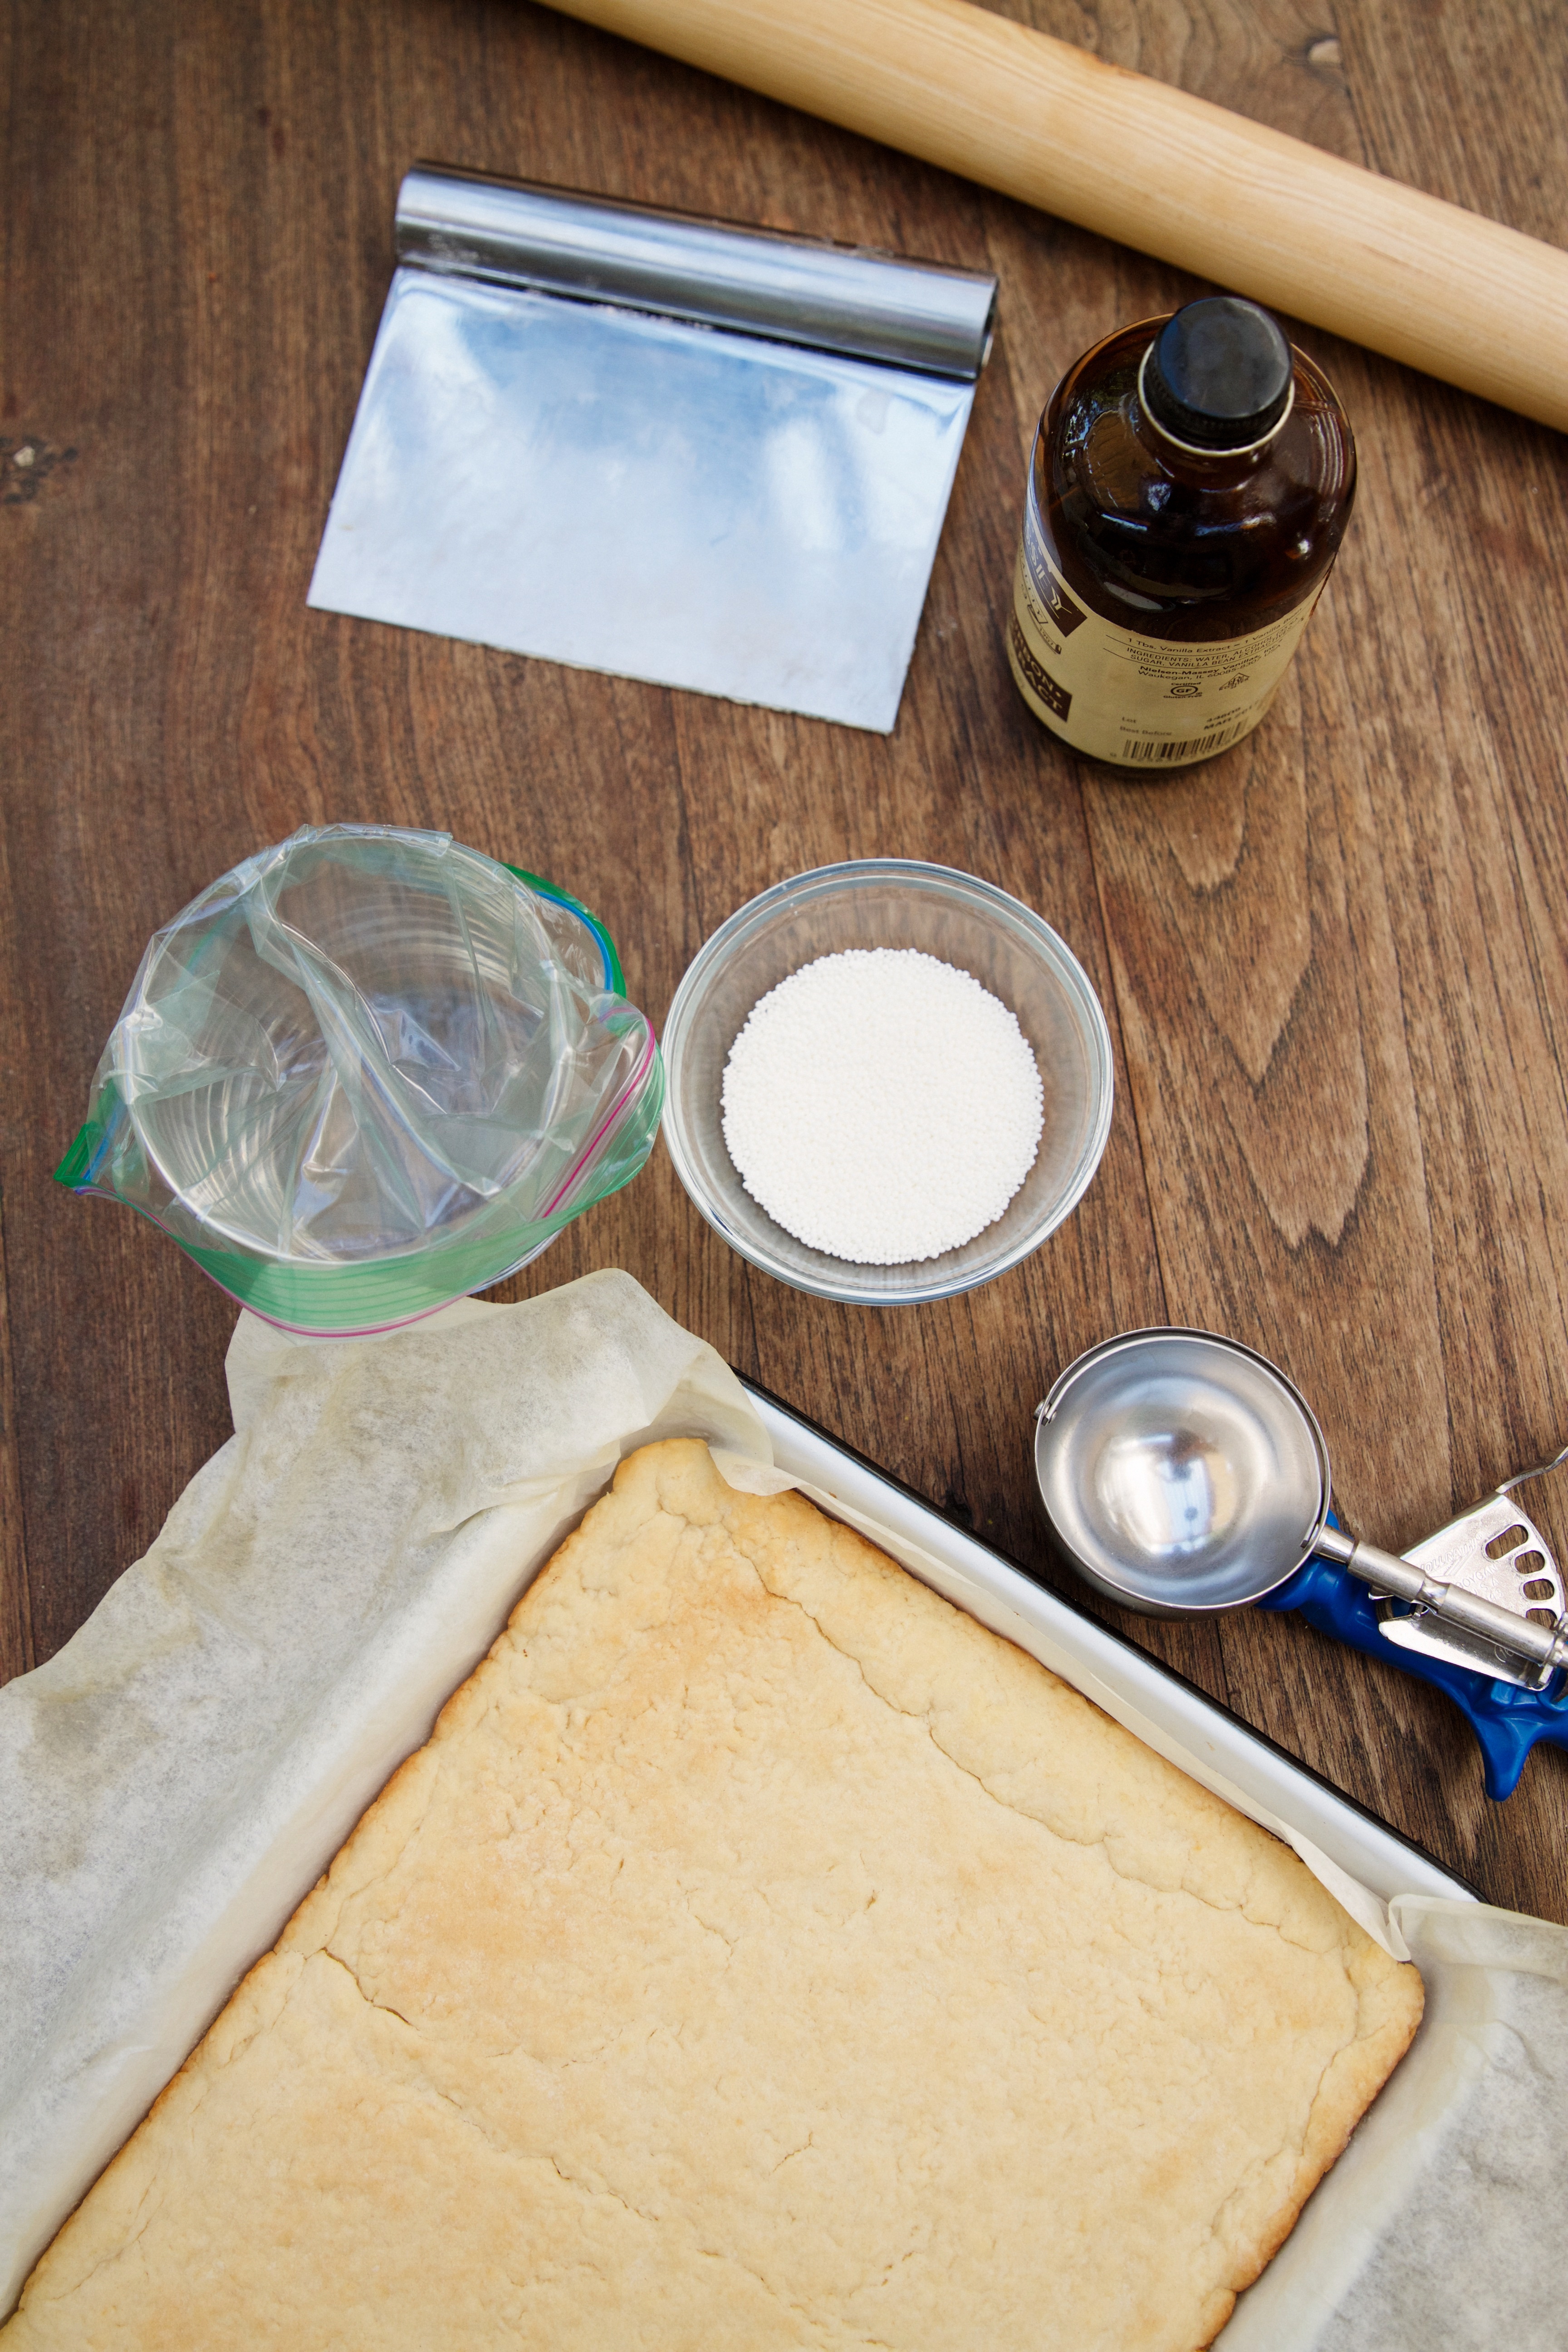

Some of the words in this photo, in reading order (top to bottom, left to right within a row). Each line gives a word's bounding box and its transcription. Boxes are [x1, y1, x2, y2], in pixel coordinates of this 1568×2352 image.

[1127, 647, 1191, 662] INGREDIENTS:
[1196, 653, 1230, 662] WATER,
[1233, 636, 1272, 656] ALCOHOL
[1130, 654, 1165, 666] SUGAR,
[1212, 657, 1235, 665] BEAN
[1239, 626, 1292, 658] EXTRACTIVES
[1136, 640, 1156, 649] Tbs.
[1252, 624, 1280, 641] Vanilla
[1138, 670, 1192, 680] Waukegan,
[1140, 666, 1220, 675] Nielsen-Massey
[1222, 654, 1261, 670] Vanillas,
